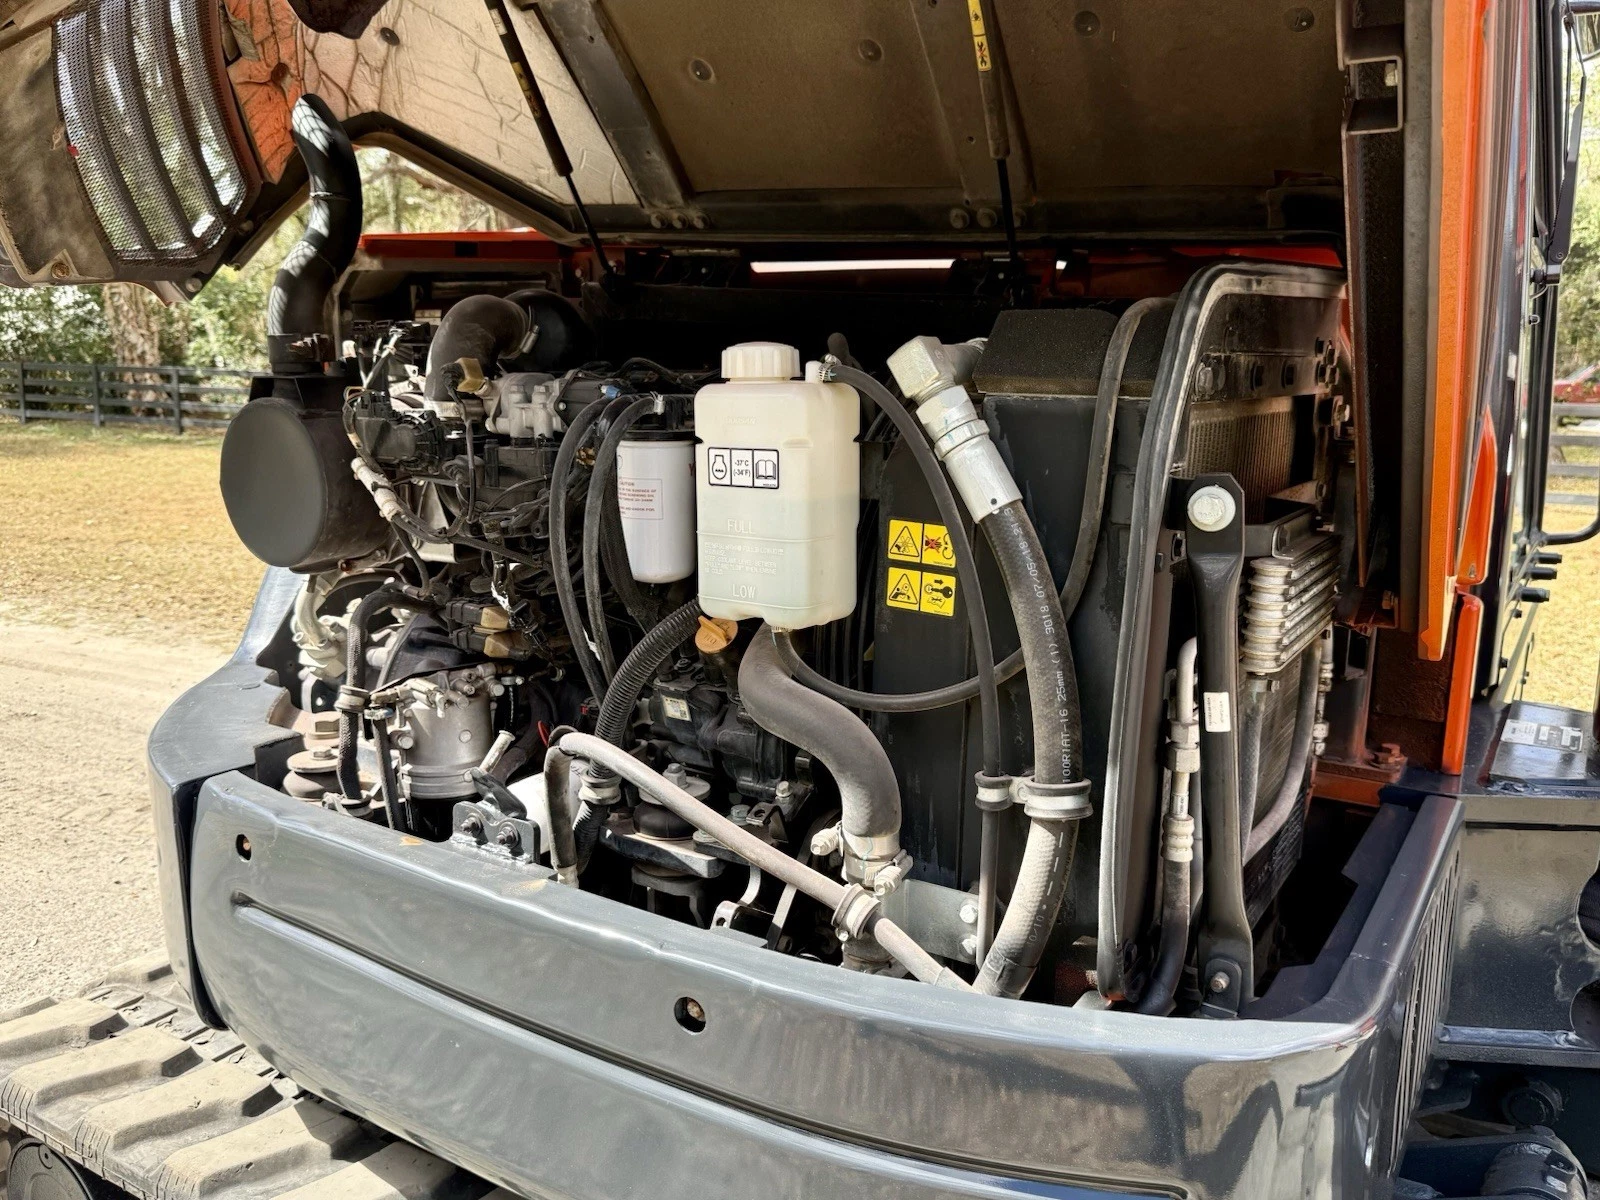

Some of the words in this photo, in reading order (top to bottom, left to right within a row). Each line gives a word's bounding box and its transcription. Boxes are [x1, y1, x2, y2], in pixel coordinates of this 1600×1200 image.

[727, 518, 756, 534] FULL
[1018, 541, 1045, 598] 07/05/18
[732, 583, 756, 598] LOW
[1056, 671, 1067, 701] 25mm
